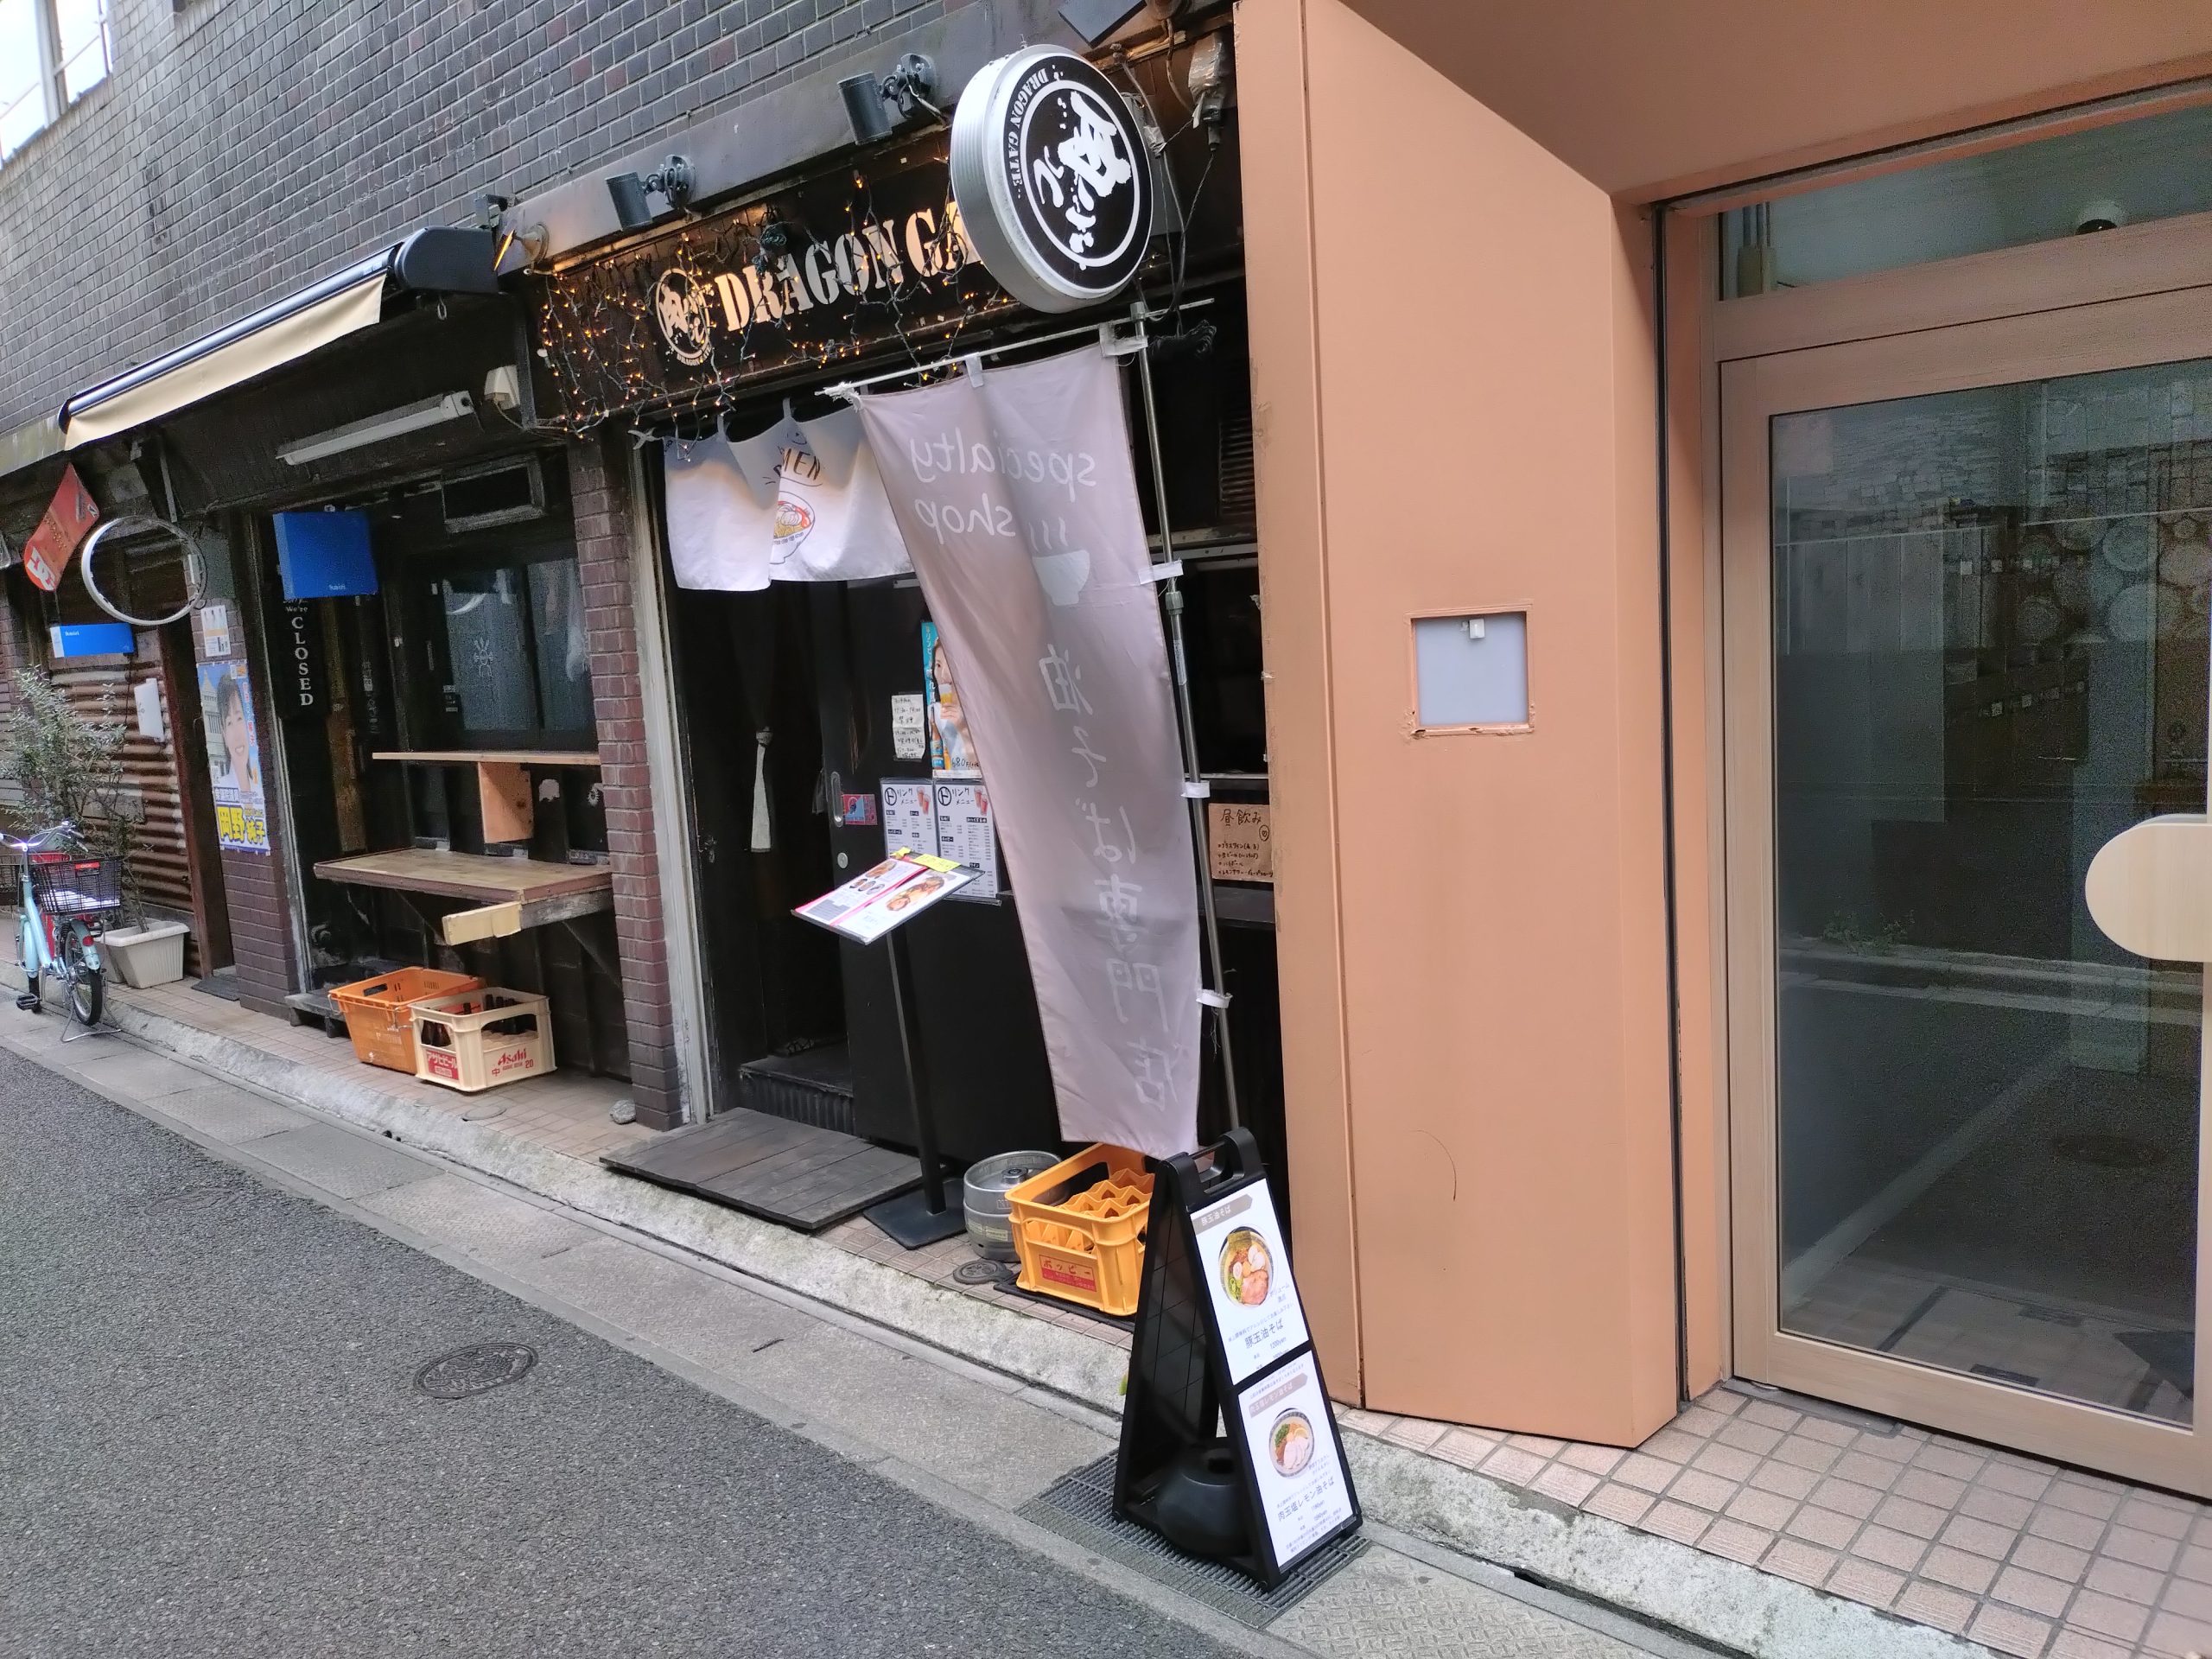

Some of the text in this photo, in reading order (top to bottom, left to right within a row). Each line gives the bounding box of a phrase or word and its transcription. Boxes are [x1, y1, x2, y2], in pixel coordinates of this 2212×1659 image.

[1007, 67, 1049, 188] DRAGON GATE
[715, 219, 905, 332] DRAGON
[291, 616, 314, 706] CLOSED
[1220, 808, 1262, 826] 昼飲み
[498, 1047, 527, 1066] Asahi
[524, 1059, 534, 1069] 20
[1043, 1258, 1091, 1275] ホッピー
[1244, 1319, 1284, 1349] 豚玉油そば
[1277, 1476, 1335, 1522] 肉玉塩レモン油そば
